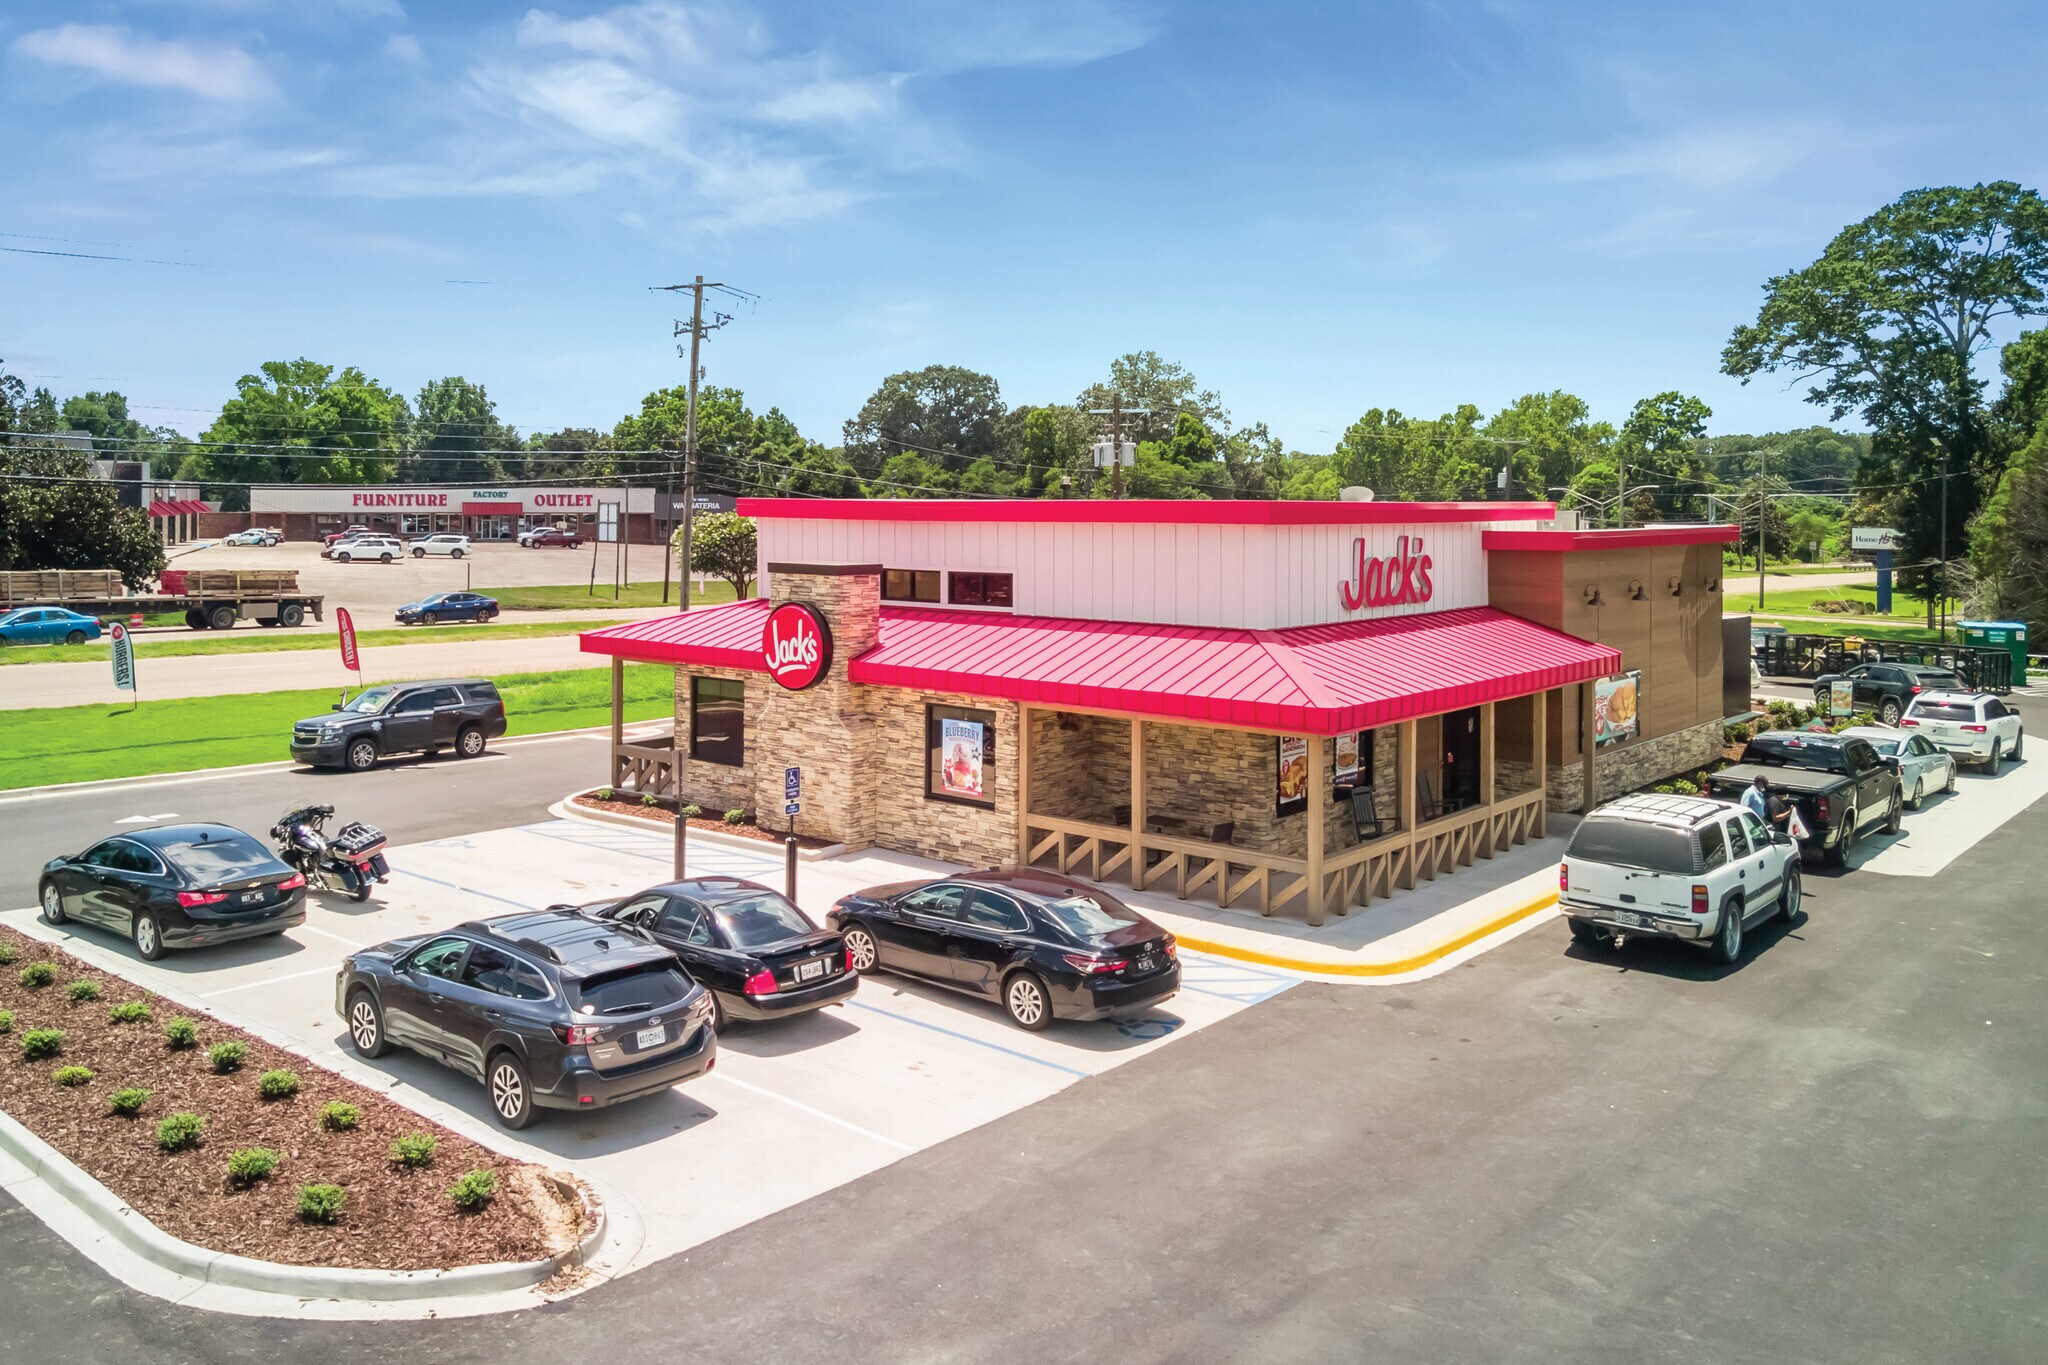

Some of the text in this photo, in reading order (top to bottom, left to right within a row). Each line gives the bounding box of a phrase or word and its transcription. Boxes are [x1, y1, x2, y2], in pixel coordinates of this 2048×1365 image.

[352, 493, 593, 507] FURNITURE OUTLET
[1338, 535, 1432, 610] Jack's
[114, 638, 130, 686] BURGERS!
[765, 619, 817, 669] Jack's
[945, 726, 979, 742] BLUEBERRY
